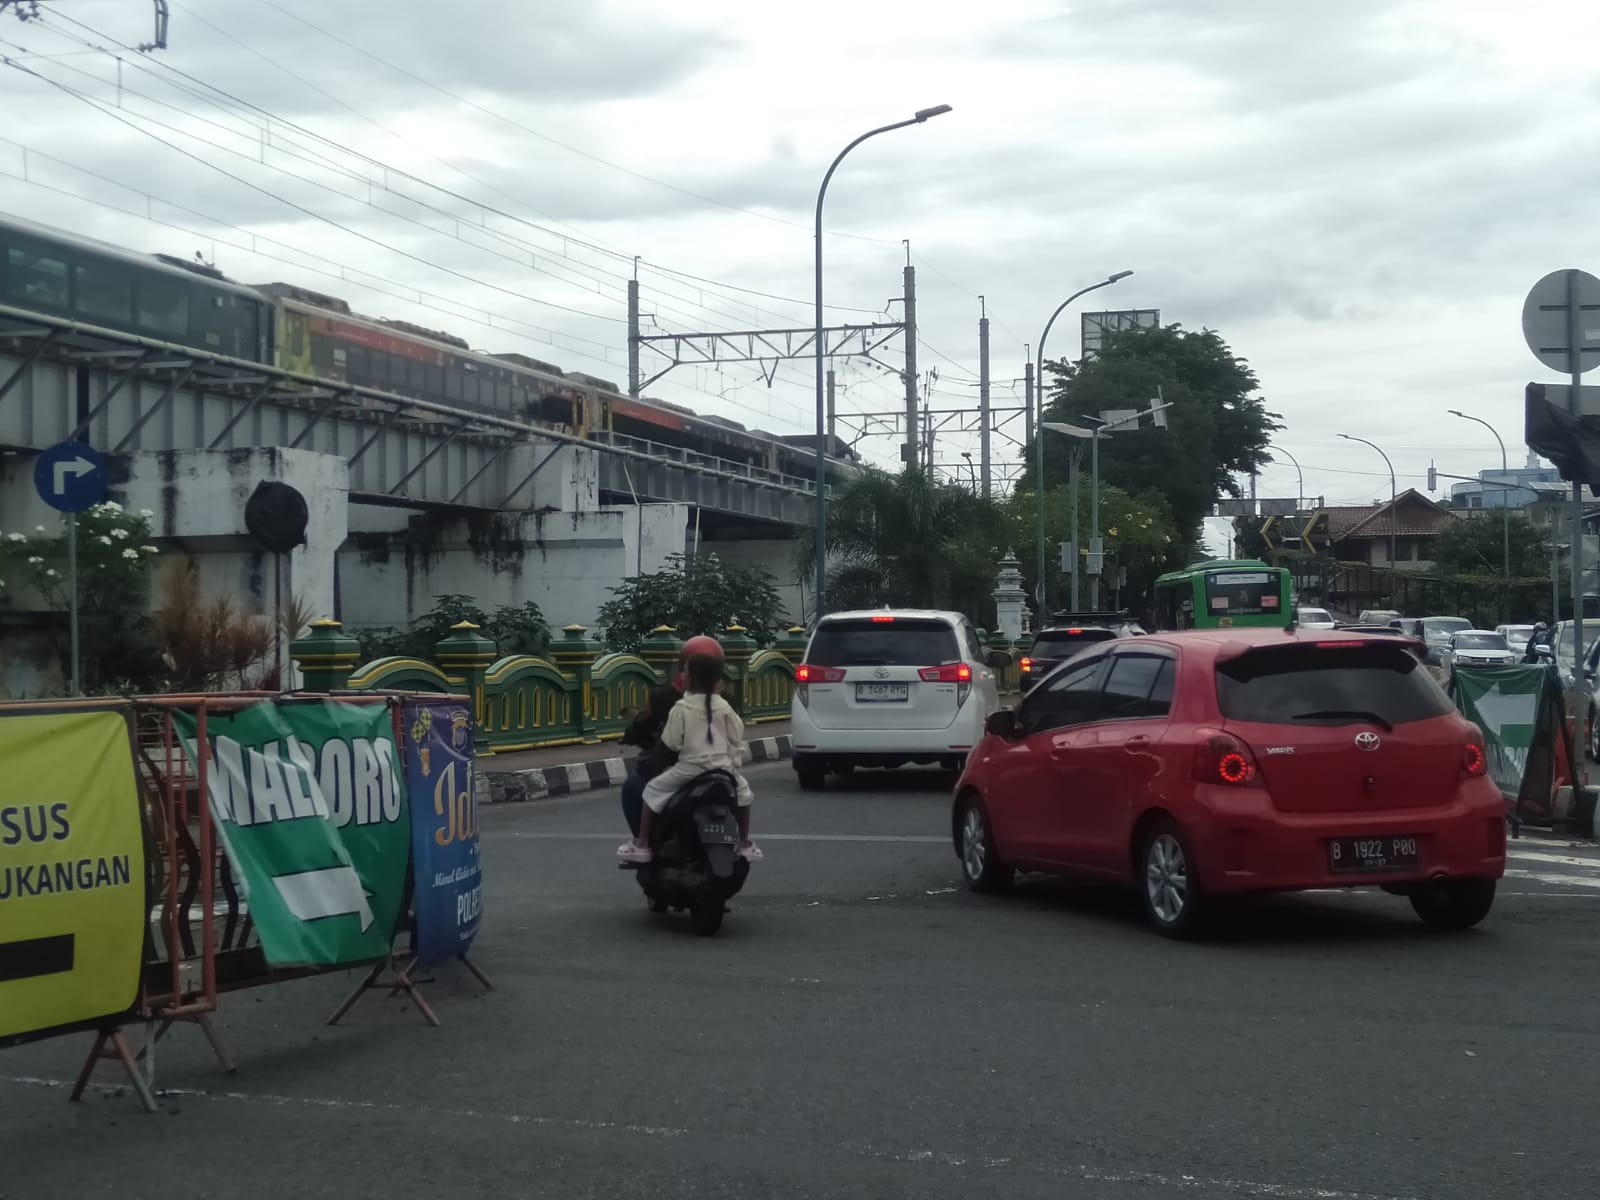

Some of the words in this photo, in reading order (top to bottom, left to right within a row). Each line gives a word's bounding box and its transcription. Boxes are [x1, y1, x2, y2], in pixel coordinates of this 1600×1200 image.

[0, 803, 70, 845] SUS
[1332, 842, 1342, 860] B
[1353, 840, 1383, 858] 1922
[0, 855, 130, 900] UKANGAN
